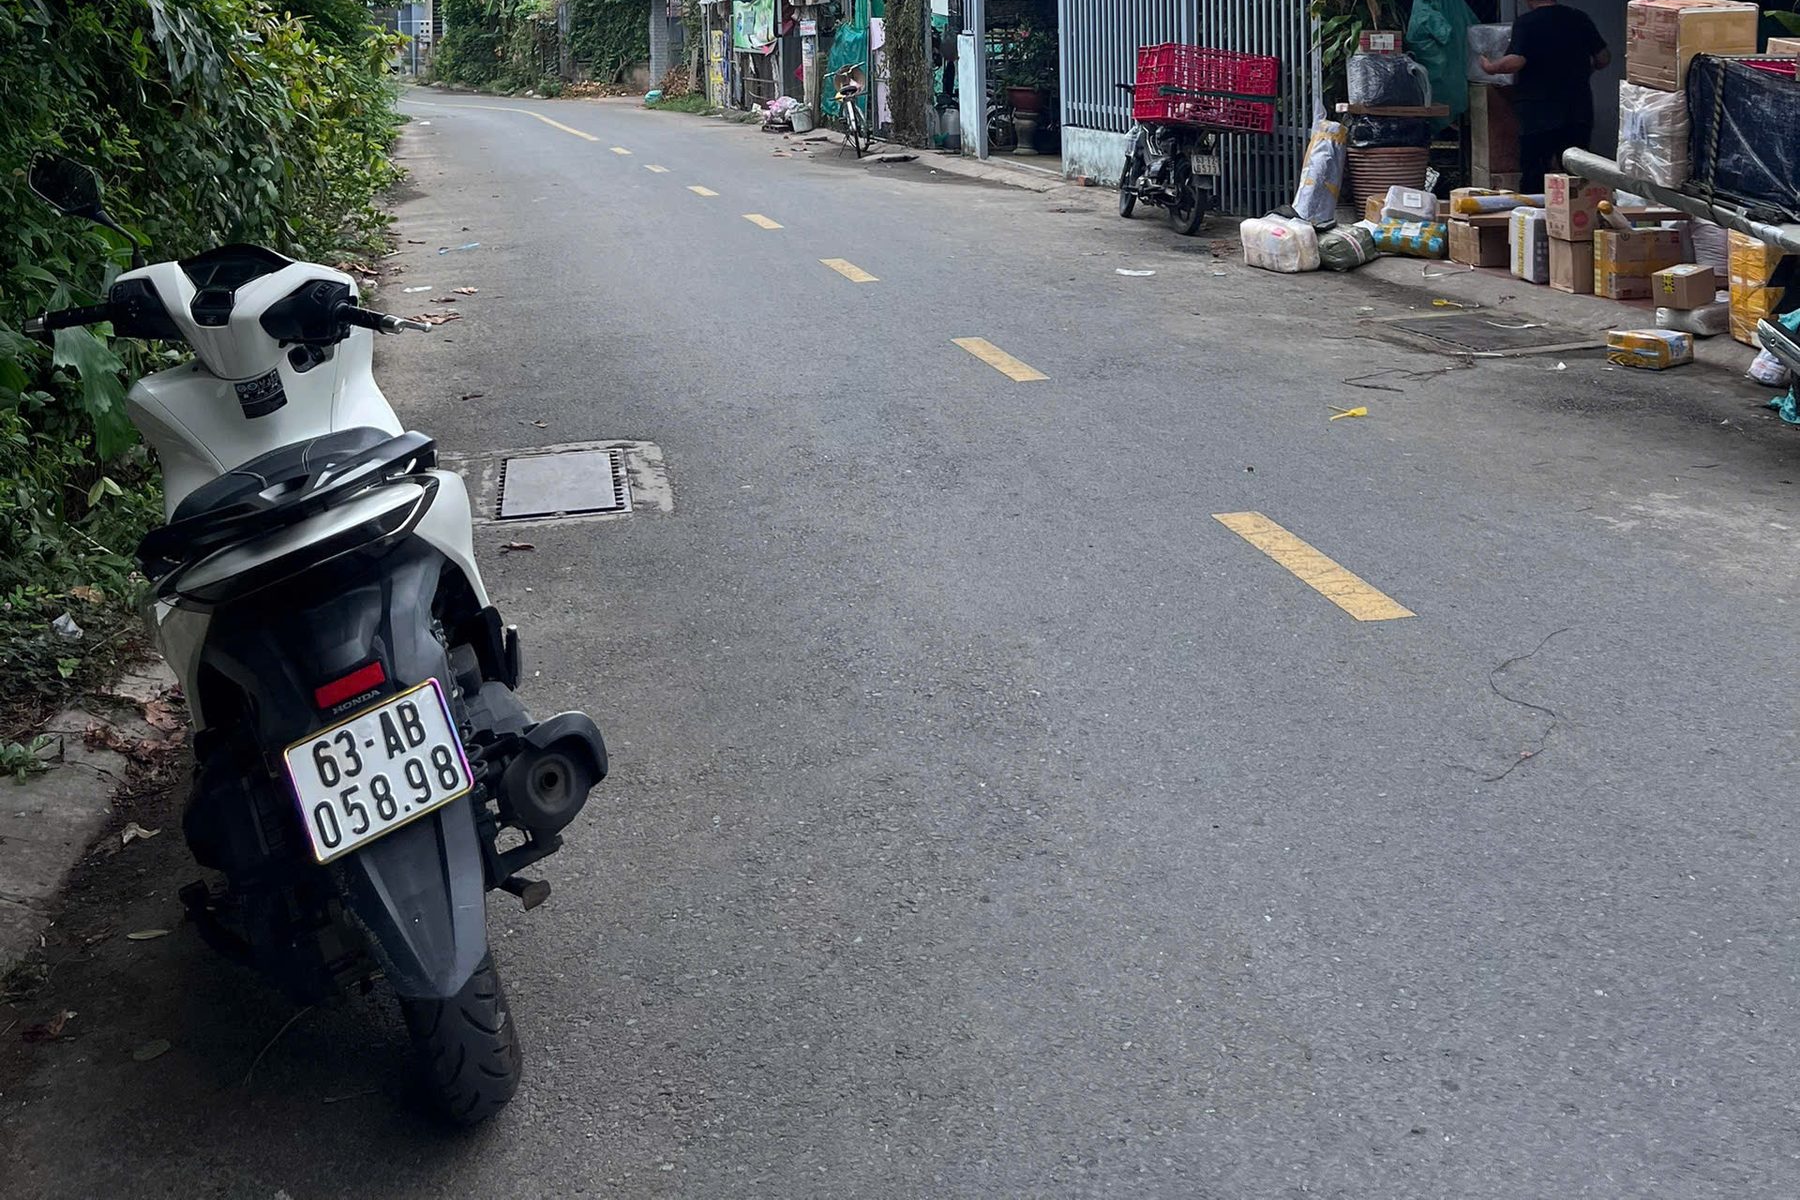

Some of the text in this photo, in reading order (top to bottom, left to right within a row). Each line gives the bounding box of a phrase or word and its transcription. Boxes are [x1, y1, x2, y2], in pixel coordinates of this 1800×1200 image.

[312, 699, 427, 788] 63-AB
[332, 689, 381, 714] HONDA
[313, 743, 460, 849] 058.98
